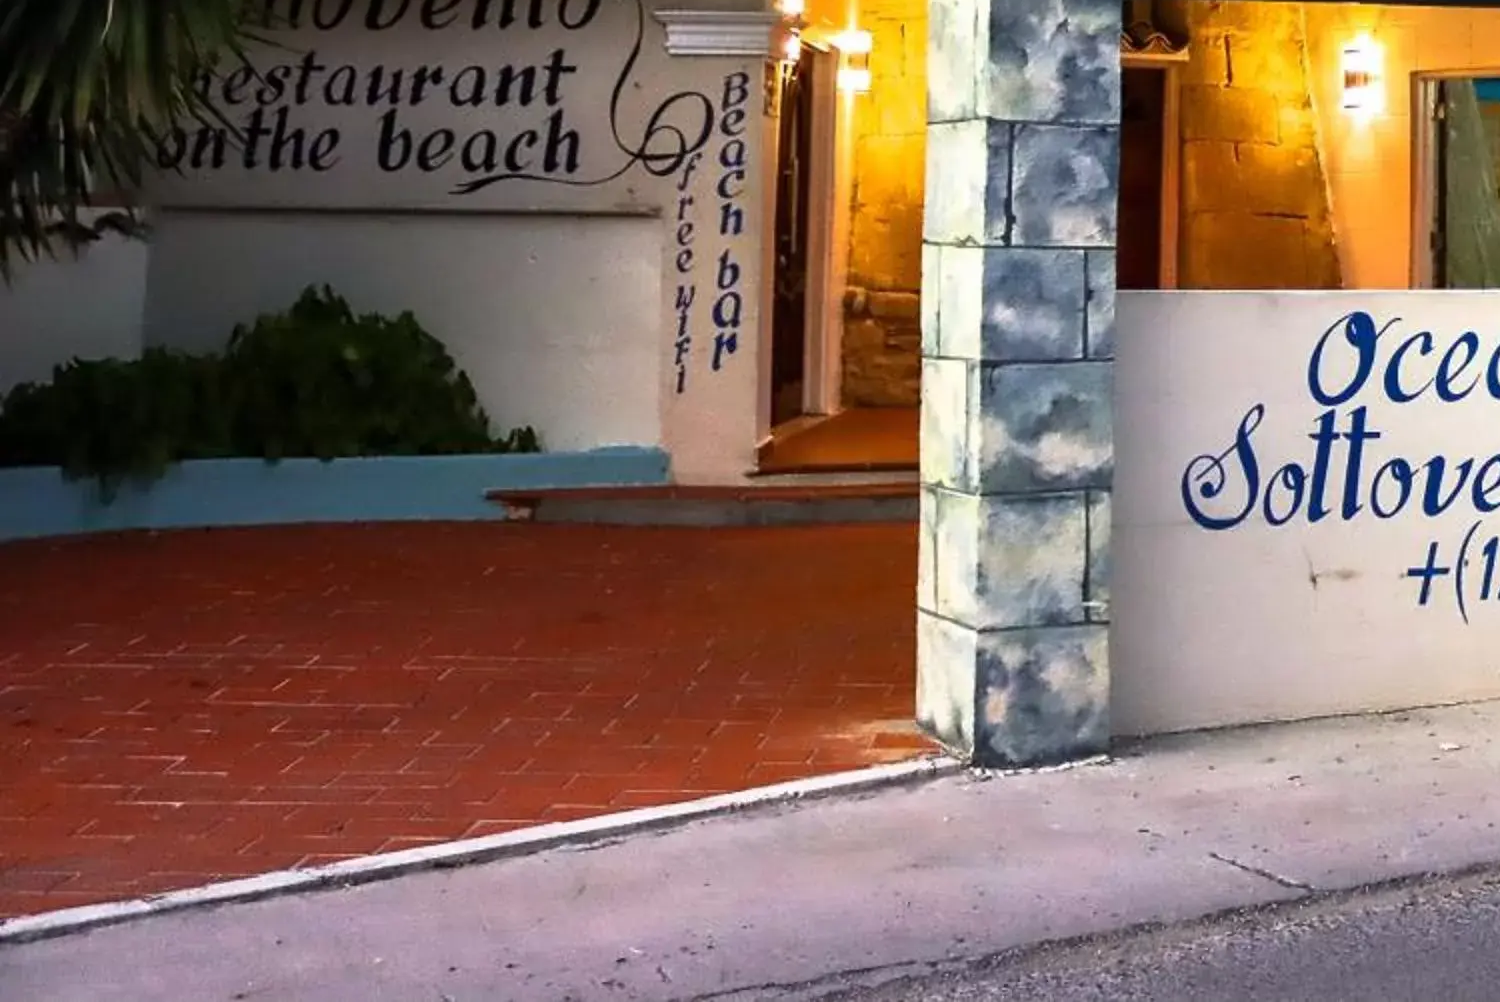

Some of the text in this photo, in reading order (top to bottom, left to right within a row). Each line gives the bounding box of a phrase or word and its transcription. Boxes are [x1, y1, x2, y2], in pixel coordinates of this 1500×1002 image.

[156, 104, 580, 173] on the beach
[675, 152, 703, 273] free
[711, 71, 750, 372] Beach bar
